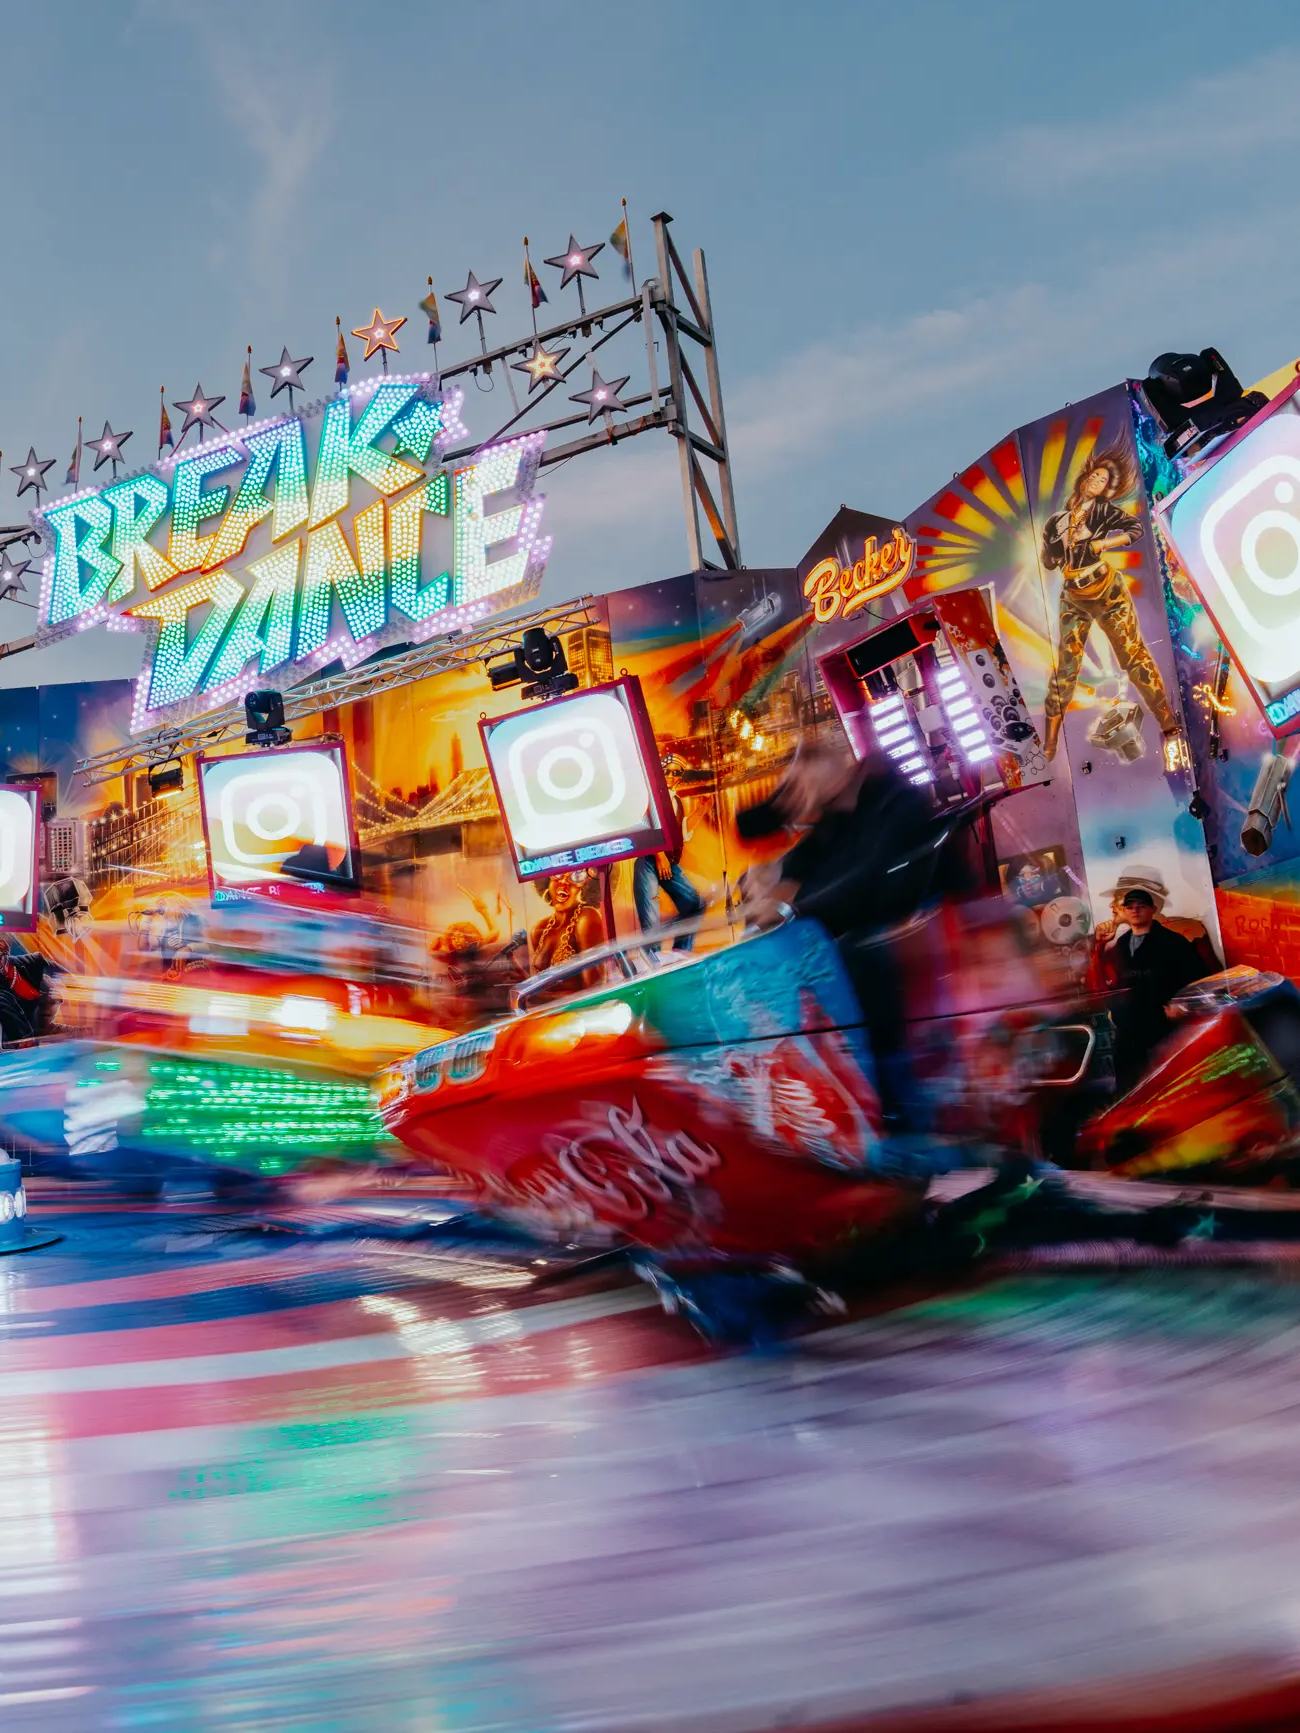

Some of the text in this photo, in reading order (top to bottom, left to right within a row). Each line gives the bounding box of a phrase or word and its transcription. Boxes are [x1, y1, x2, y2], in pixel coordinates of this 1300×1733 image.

[42, 383, 427, 626] BREAK
[121, 448, 527, 712] DANCE
[803, 526, 916, 623] Becker
